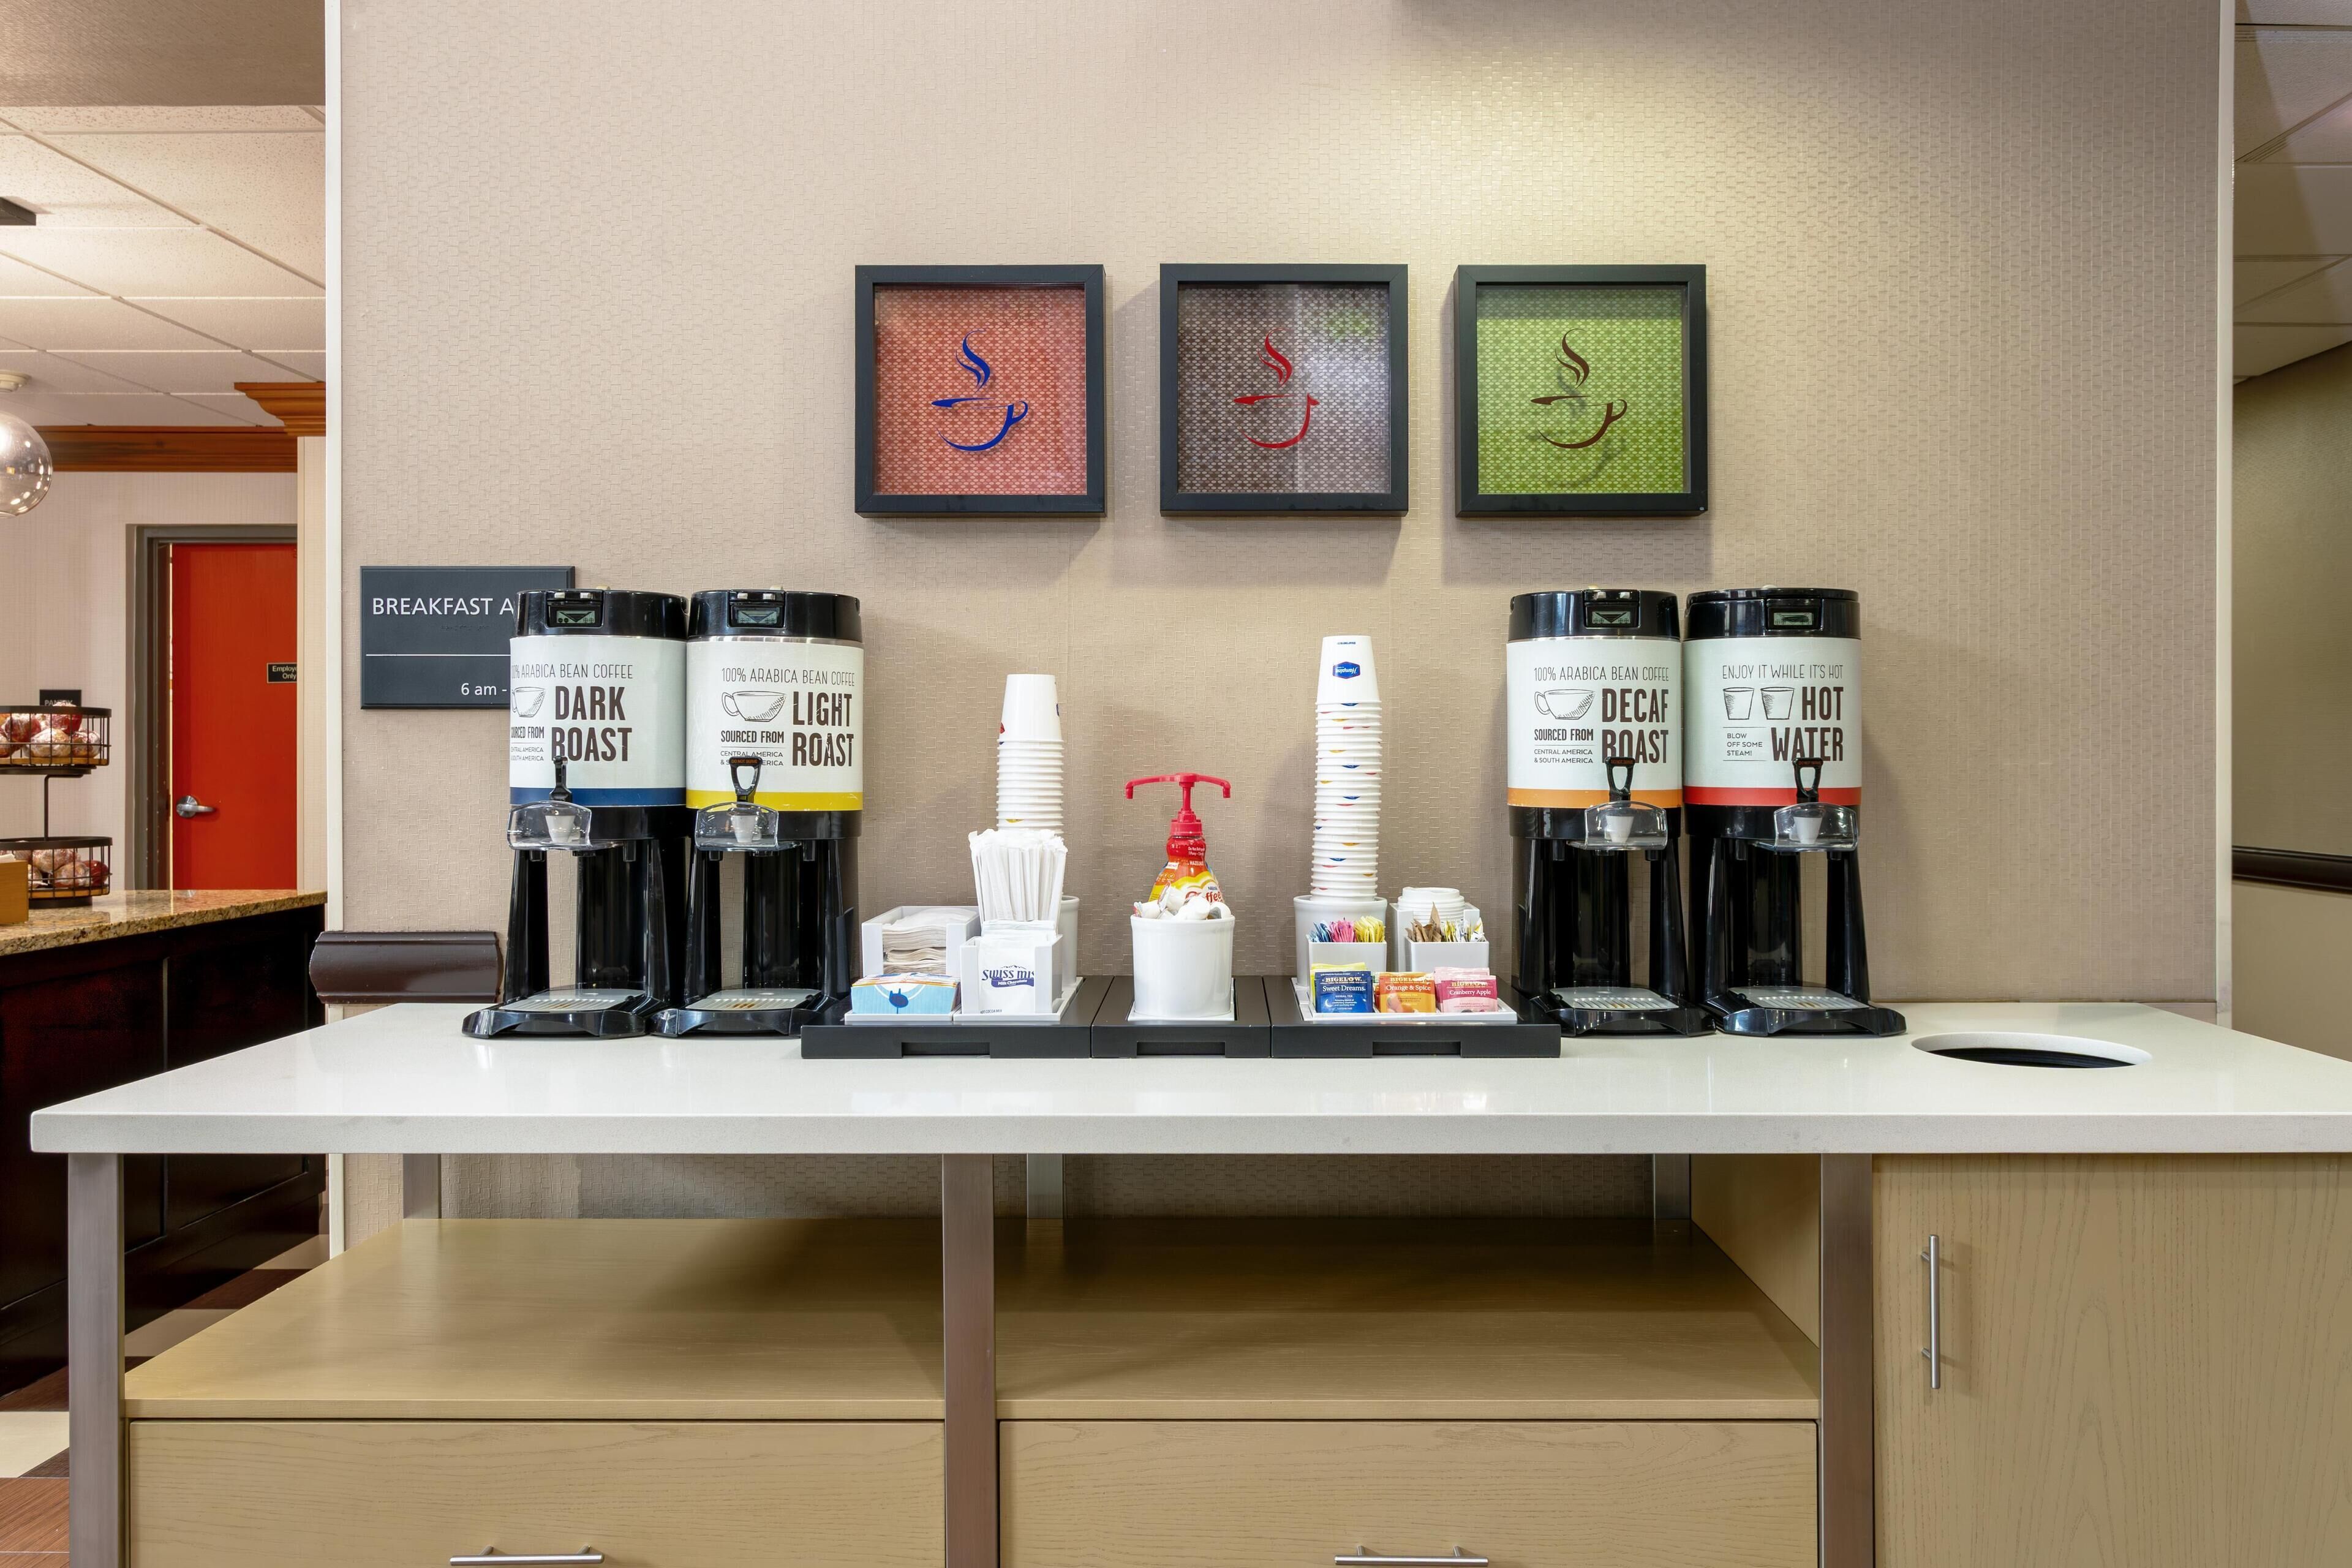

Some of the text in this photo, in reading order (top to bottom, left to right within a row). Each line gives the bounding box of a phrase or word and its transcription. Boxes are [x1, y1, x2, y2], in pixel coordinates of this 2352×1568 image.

[372, 597, 493, 616] BREAKFAST
[521, 663, 556, 678] ARABICA
[560, 663, 588, 678] BEAN
[594, 664, 633, 679] COFFEE
[722, 668, 855, 687] 100% ARABICA BEAN COFFEE
[1534, 666, 1669, 682] 100% ARABICA BEAN COFFEE
[1722, 665, 1844, 679] ENJOY IT WHILE IT'S HOT
[461, 683, 469, 696] 6
[474, 685, 497, 696] am
[555, 685, 626, 720] DARK
[793, 691, 852, 727] LIGHT
[1602, 688, 1669, 723] DECAF
[1801, 686, 1844, 720] HOT
[528, 726, 545, 739] FROM
[721, 730, 784, 744] SOURCED FROM
[1534, 728, 1594, 741] SOURCED FROM
[551, 727, 633, 762] ROAST
[792, 732, 854, 767] ROAST
[1602, 729, 1669, 764] ROAST
[1770, 727, 1844, 762] WATER
